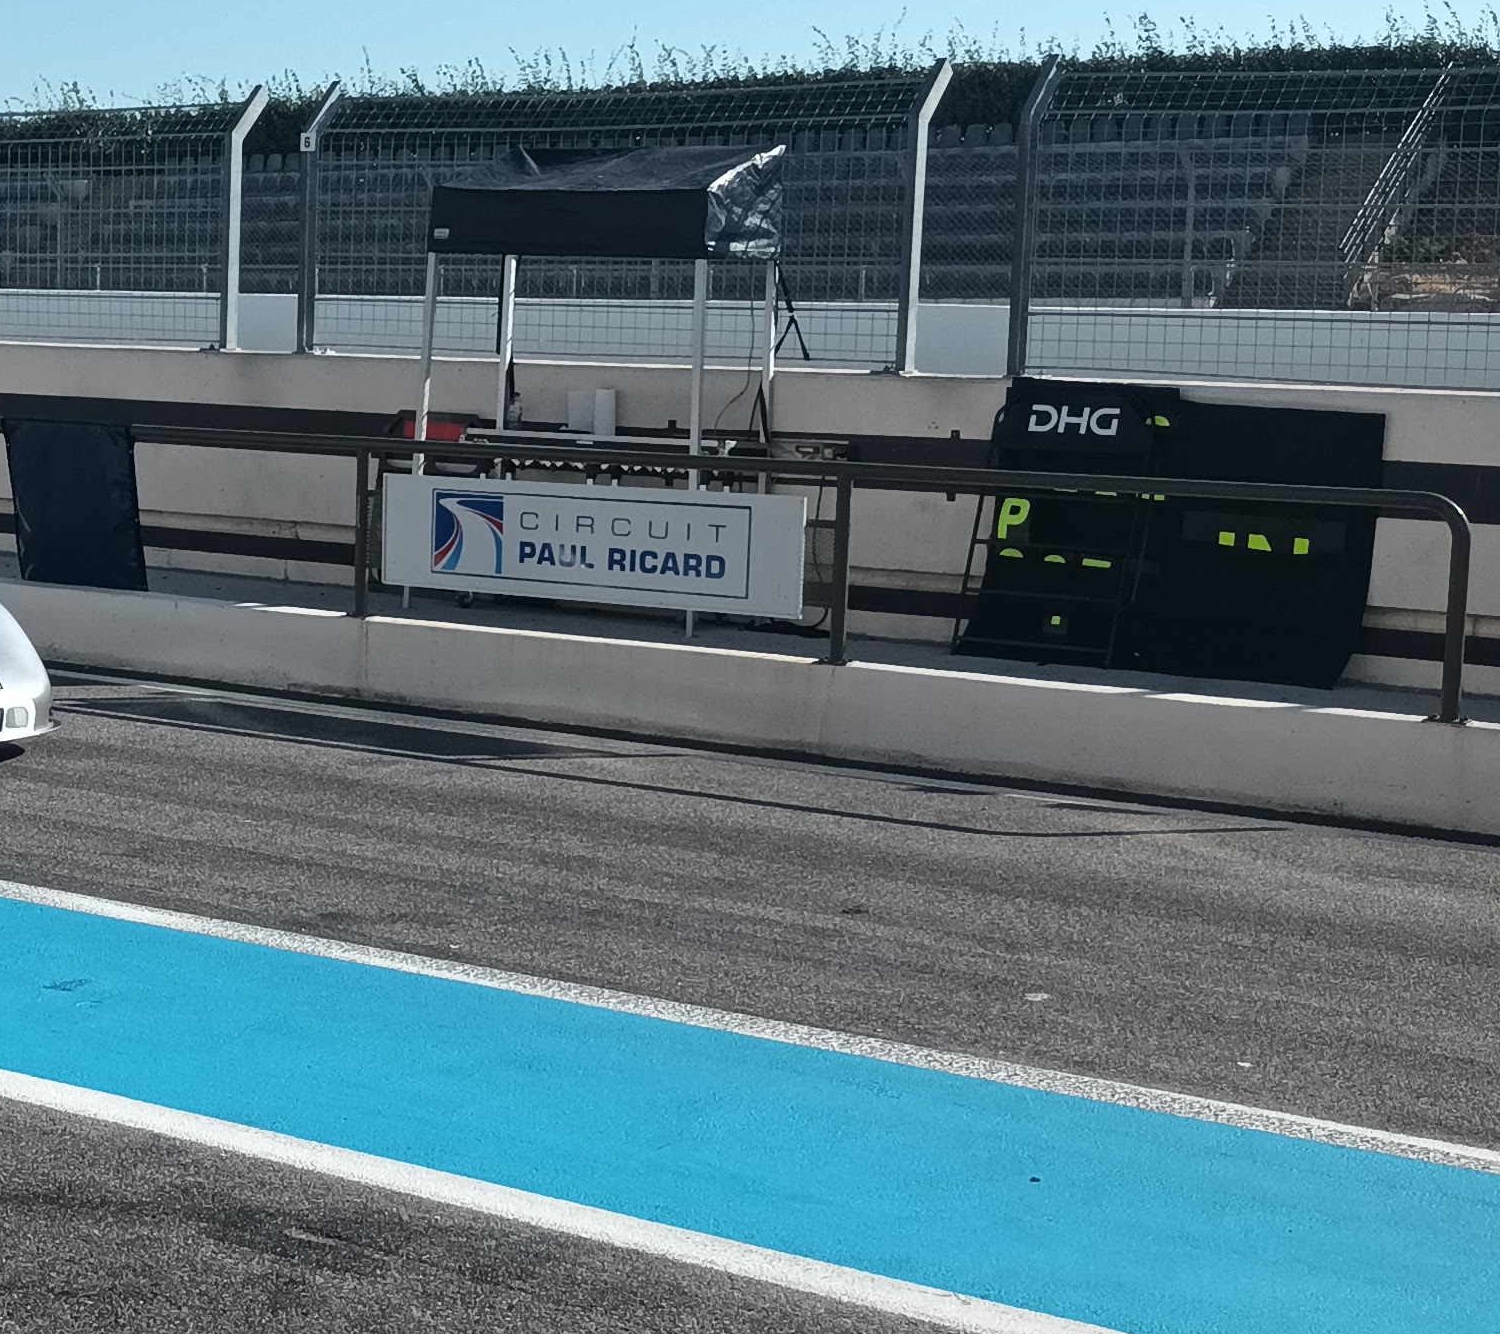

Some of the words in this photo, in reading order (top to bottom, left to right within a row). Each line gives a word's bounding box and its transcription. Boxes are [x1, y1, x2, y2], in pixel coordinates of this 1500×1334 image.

[303, 136, 311, 149] 6
[1027, 403, 1121, 436] DHG
[519, 511, 727, 544] CIRCUIT
[518, 541, 595, 569] PAUL
[607, 547, 727, 580] RICARD
